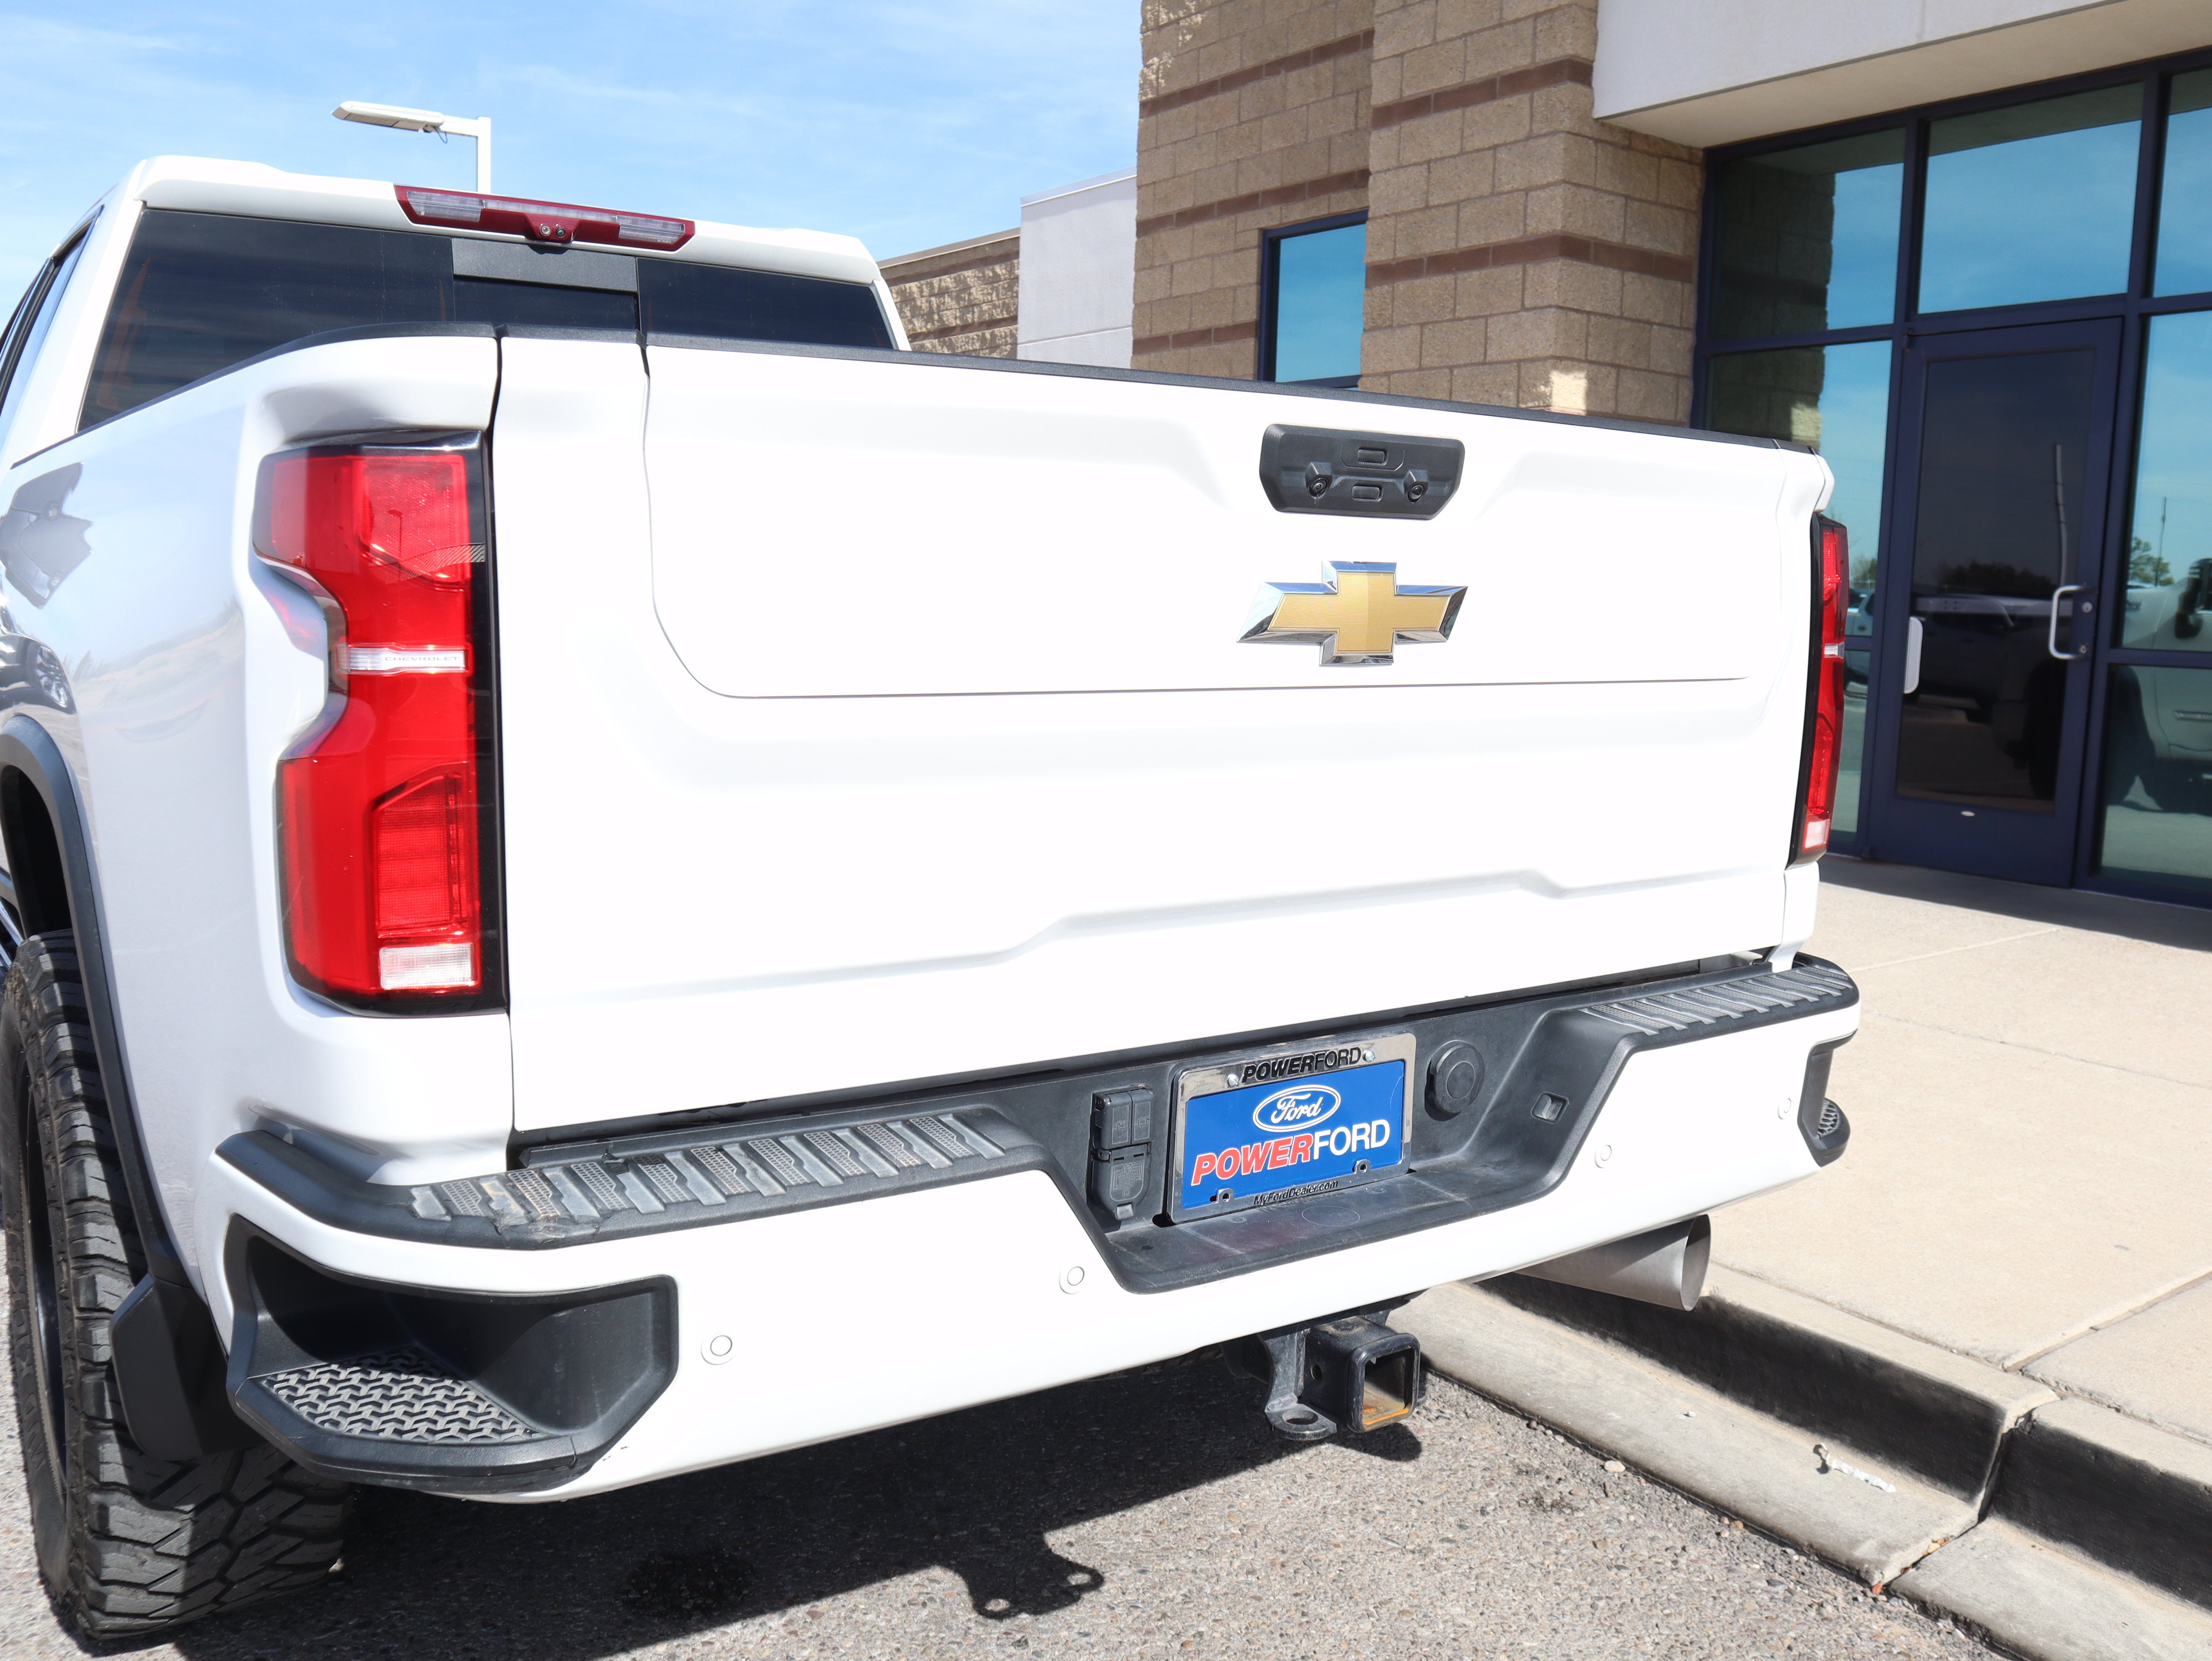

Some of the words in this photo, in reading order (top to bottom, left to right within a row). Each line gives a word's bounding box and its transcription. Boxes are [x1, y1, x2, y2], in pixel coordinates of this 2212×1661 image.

[1241, 1047, 1361, 1083] POWERFORD
[1271, 1093, 1324, 1124] Ford
[1191, 1119, 1391, 1186] POWERFORD
[1253, 1180, 1338, 1205] MyFordDealer.com
[5, 1212, 33, 1378] KICKER
